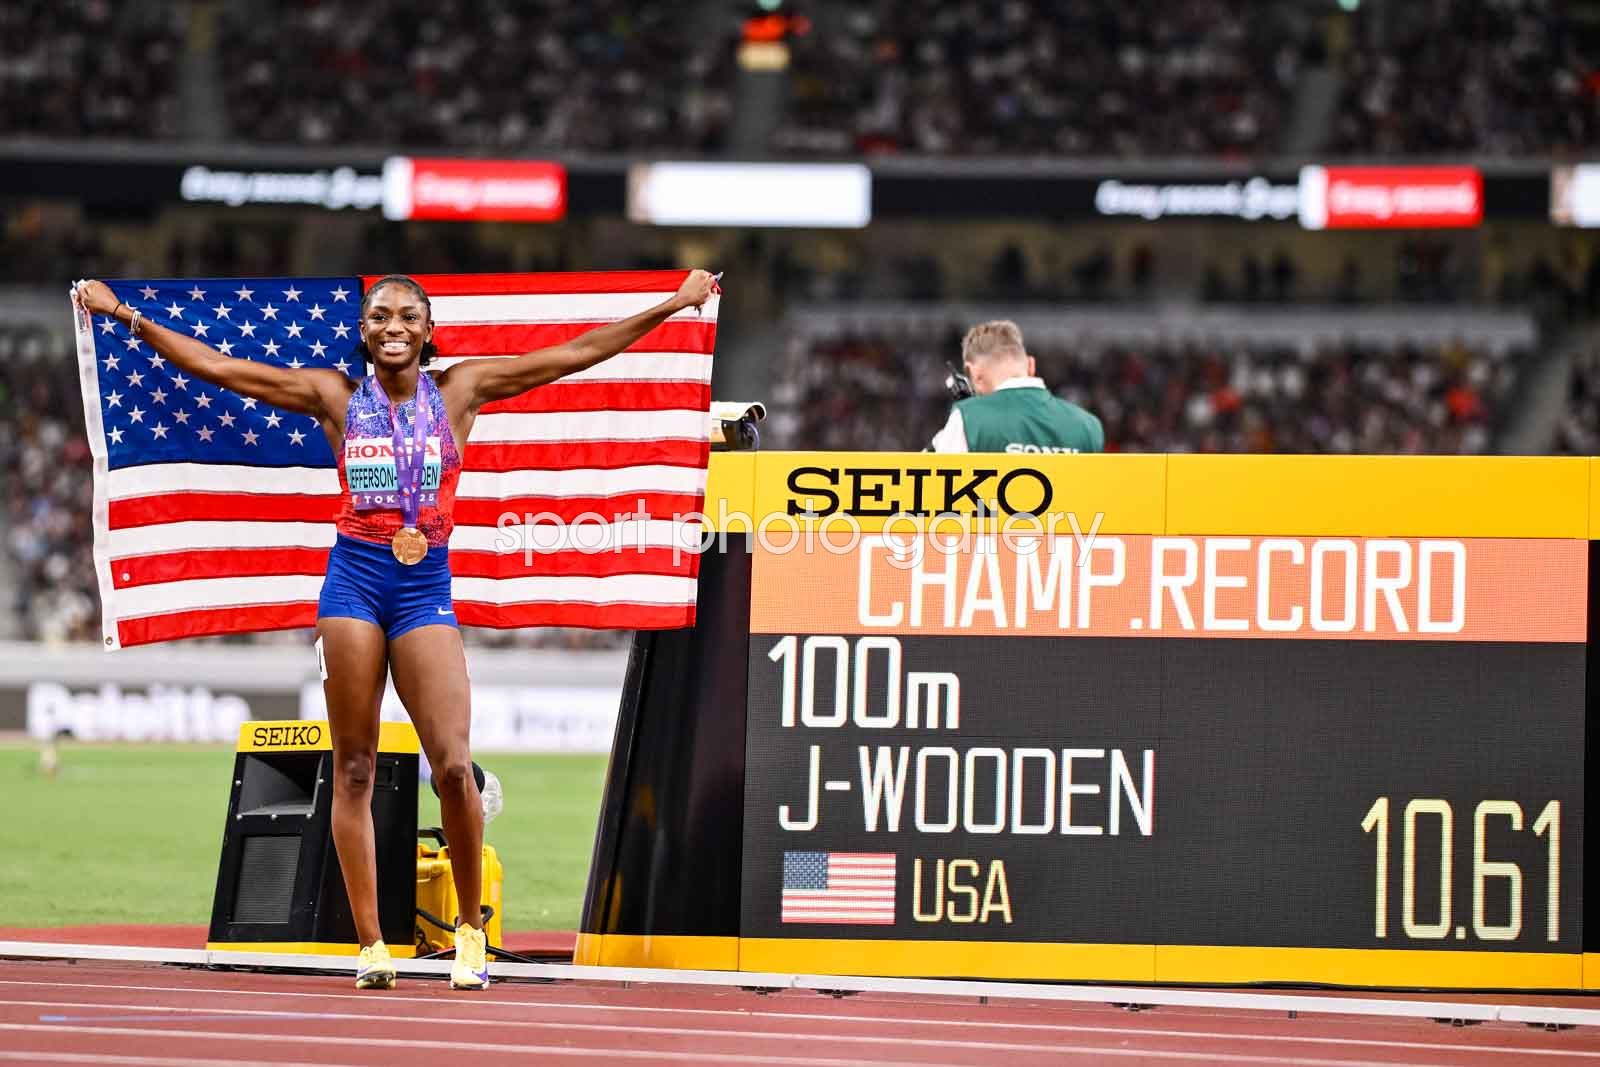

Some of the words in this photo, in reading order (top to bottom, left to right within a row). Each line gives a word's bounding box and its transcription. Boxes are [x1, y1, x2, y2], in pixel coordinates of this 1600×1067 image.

[350, 466, 438, 489] JEFFERSON-DEN
[364, 495, 402, 504] TOK
[785, 467, 1053, 519] SEIKO
[857, 537, 1467, 633] CHAMP.RECORD
[767, 635, 960, 729] 100m
[252, 726, 321, 747] SEIKO
[778, 745, 1155, 837] J-WOODEN
[913, 858, 1013, 924] USA
[1361, 797, 1561, 941] 10.61
